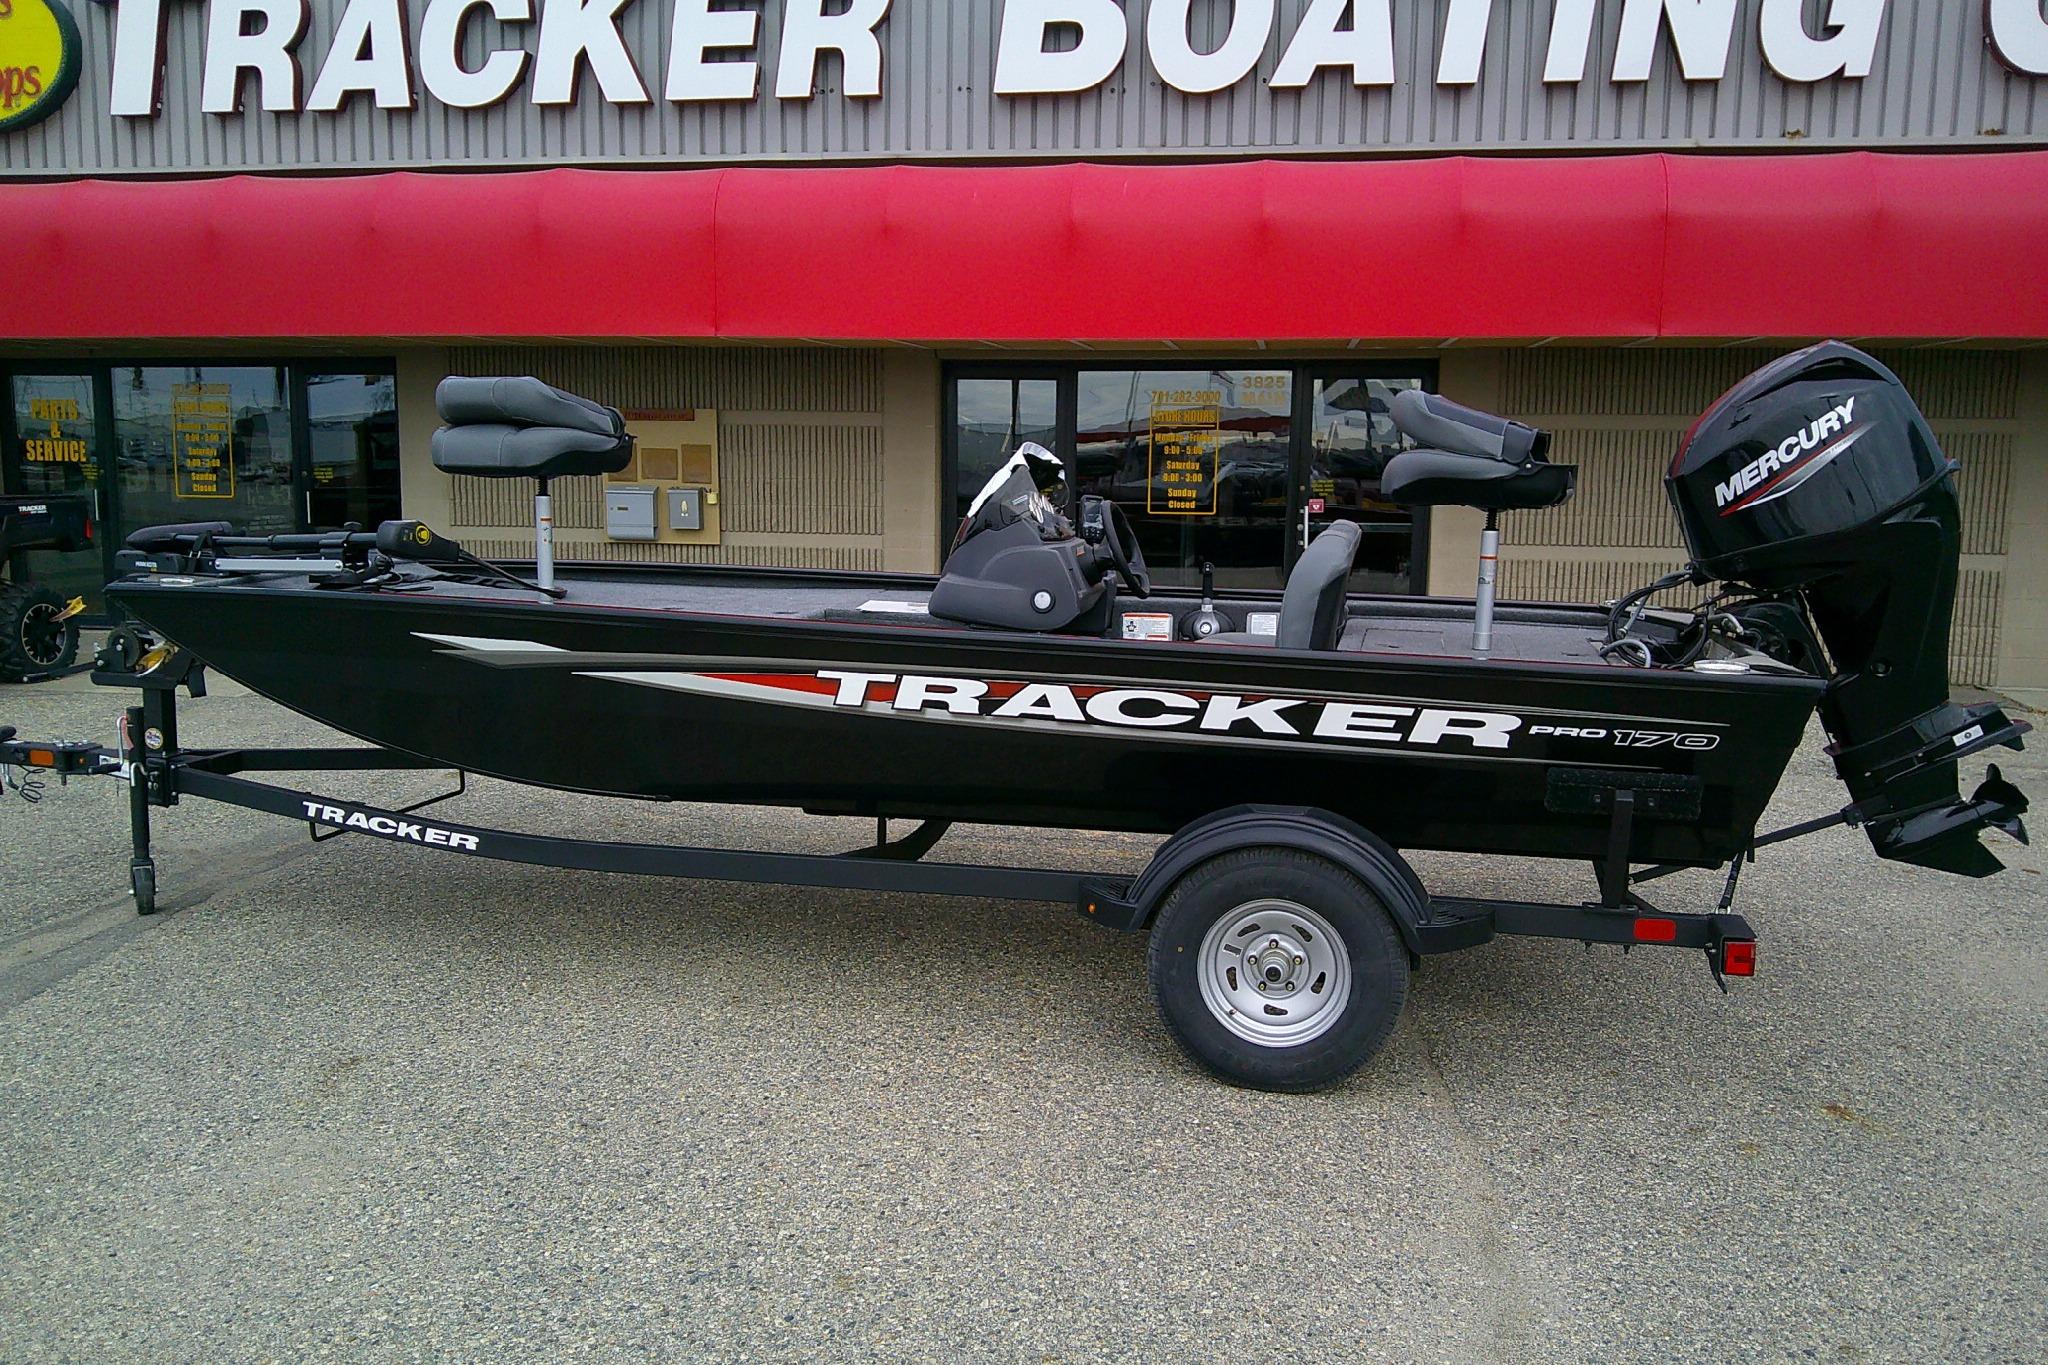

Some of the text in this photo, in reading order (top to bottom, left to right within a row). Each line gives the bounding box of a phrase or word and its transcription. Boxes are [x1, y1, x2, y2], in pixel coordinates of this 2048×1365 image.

[110, 0, 885, 116] TRACKER
[993, 0, 1884, 94] BOATING
[1243, 377, 1286, 389] 3825
[26, 440, 87, 462] SERVICE
[1714, 395, 1855, 507] MERCURY
[1166, 461, 1200, 471] Saturday
[1167, 488, 1197, 499] Sunday
[1168, 501, 1196, 509] Closed
[816, 669, 1521, 749] TRACKER
[1528, 725, 1720, 750] PRO 170
[302, 801, 480, 851] TRACKER
